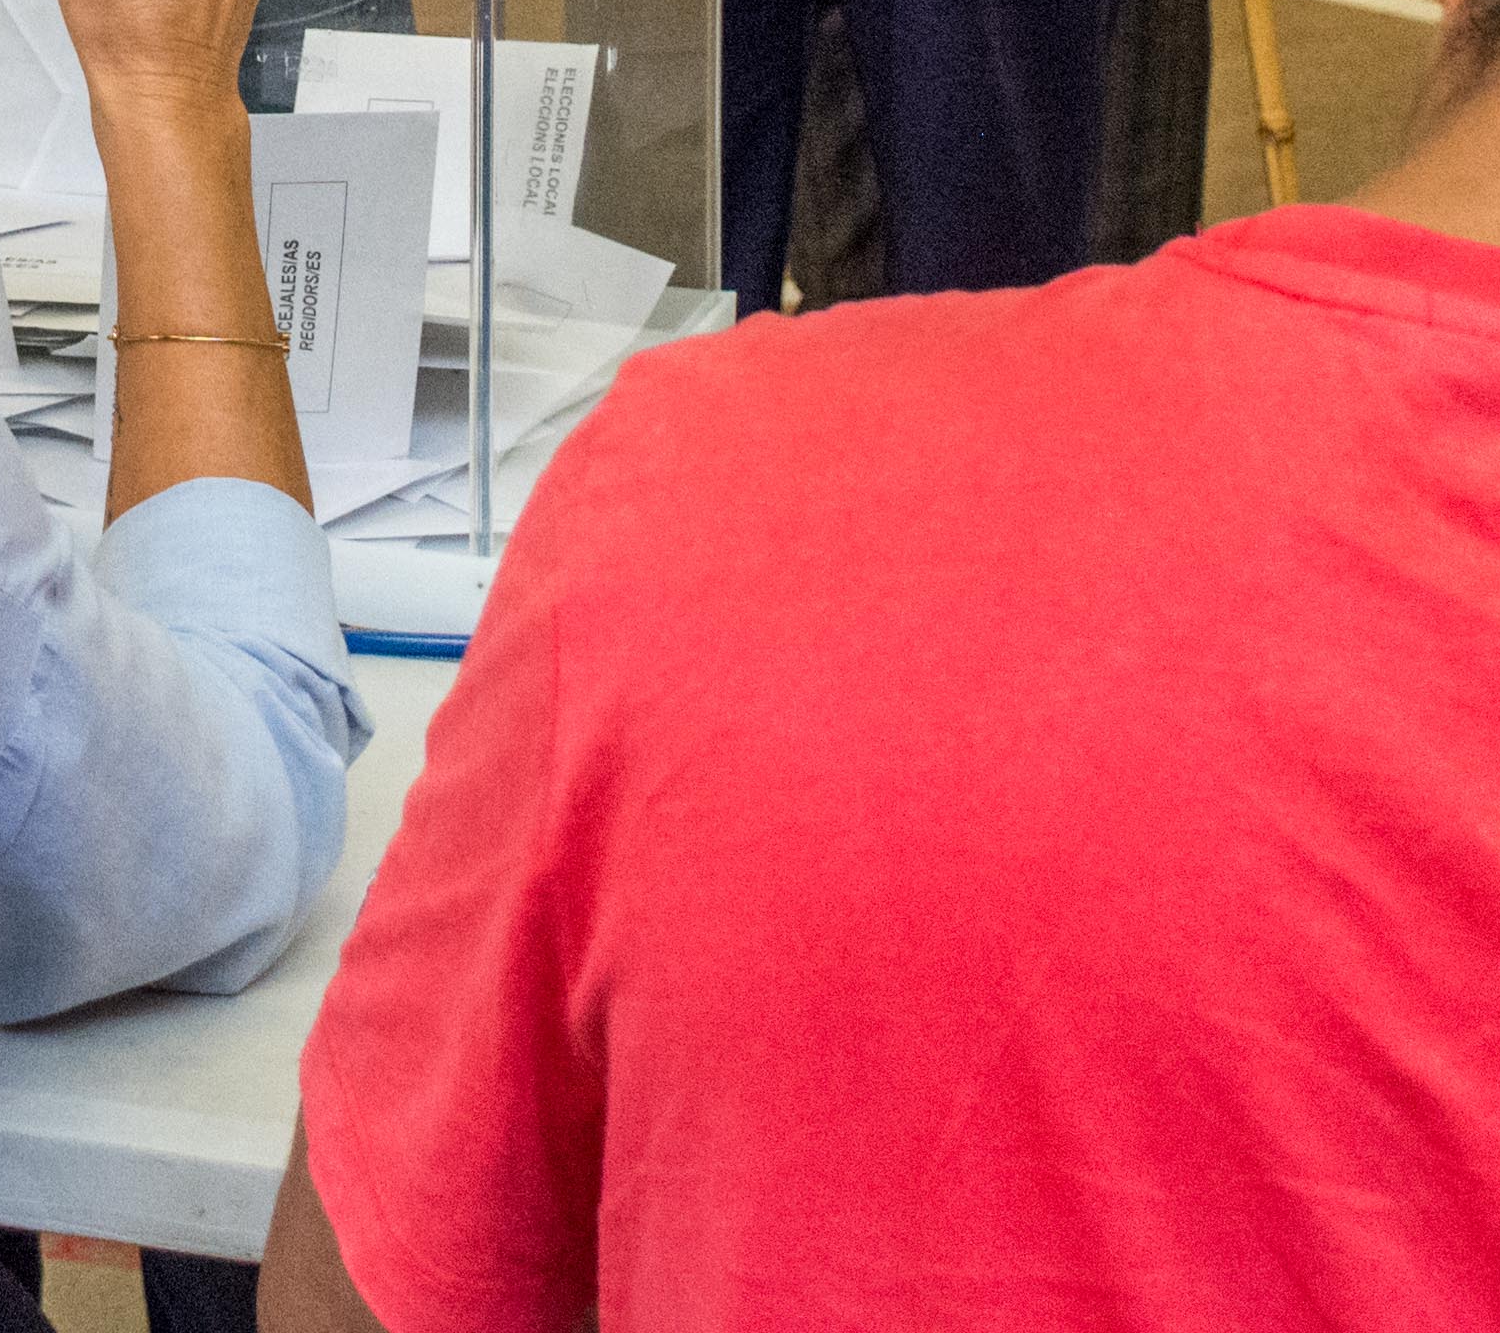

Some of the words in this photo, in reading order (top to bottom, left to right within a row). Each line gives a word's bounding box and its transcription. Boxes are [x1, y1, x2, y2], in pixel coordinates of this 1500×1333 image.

[532, 66, 560, 153] ELECCIONS
[550, 67, 577, 165] ELECCIONES
[522, 156, 544, 208] LOCAL
[277, 239, 300, 357] CEJALES/AS
[299, 249, 322, 352] REGIDORS/ES
